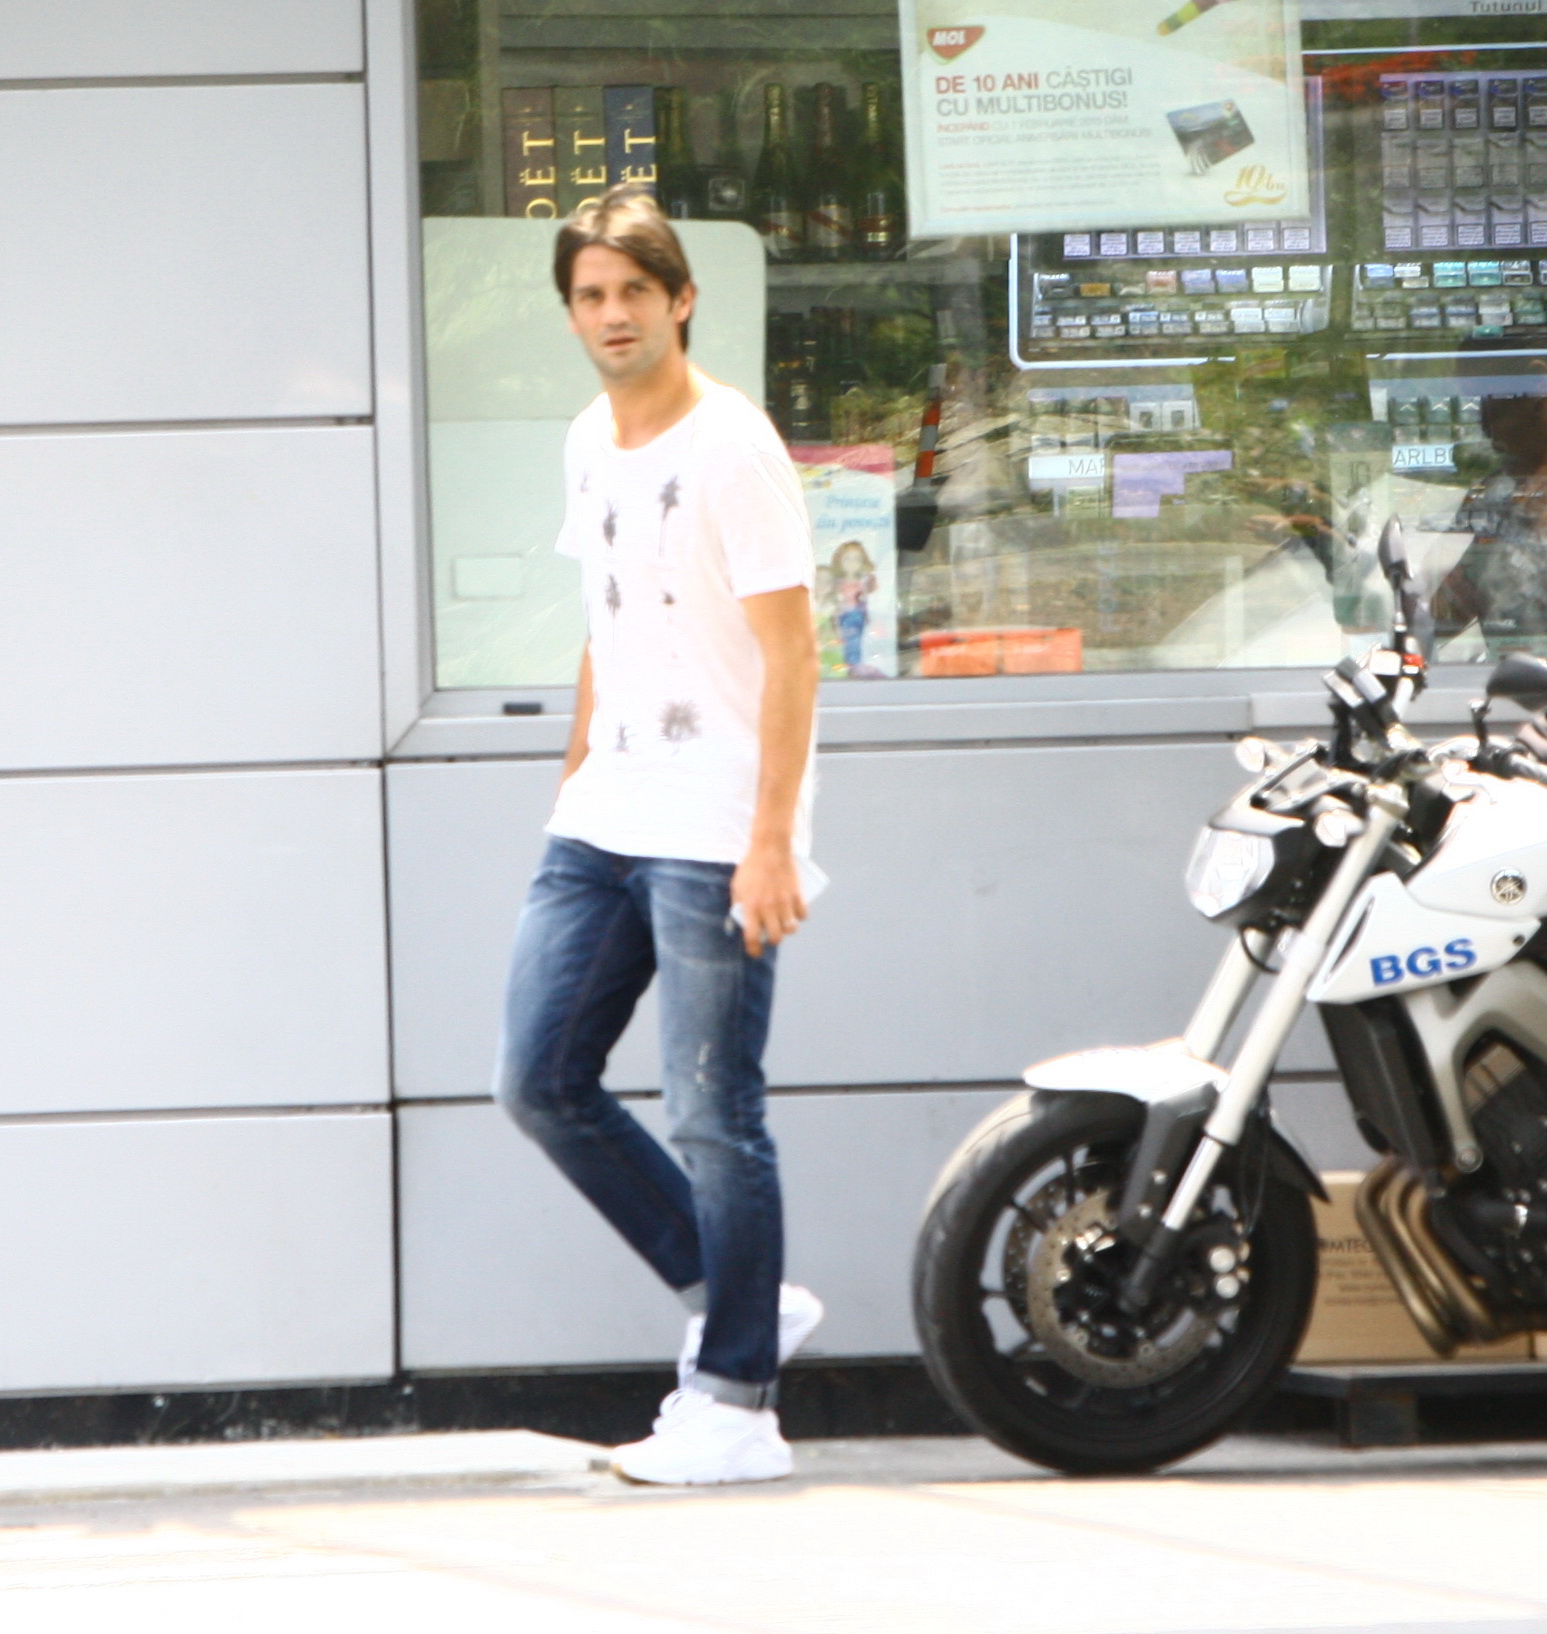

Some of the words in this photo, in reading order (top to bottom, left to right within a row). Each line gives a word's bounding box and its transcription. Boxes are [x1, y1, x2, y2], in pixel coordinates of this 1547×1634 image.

[933, 29, 967, 46] MOL
[935, 75, 967, 94] DE
[972, 73, 996, 92] 10
[1001, 71, 1039, 91] ANI
[936, 97, 969, 116] CU
[975, 90, 1128, 115] MULTIBONUS!
[1369, 938, 1477, 986] BGS
